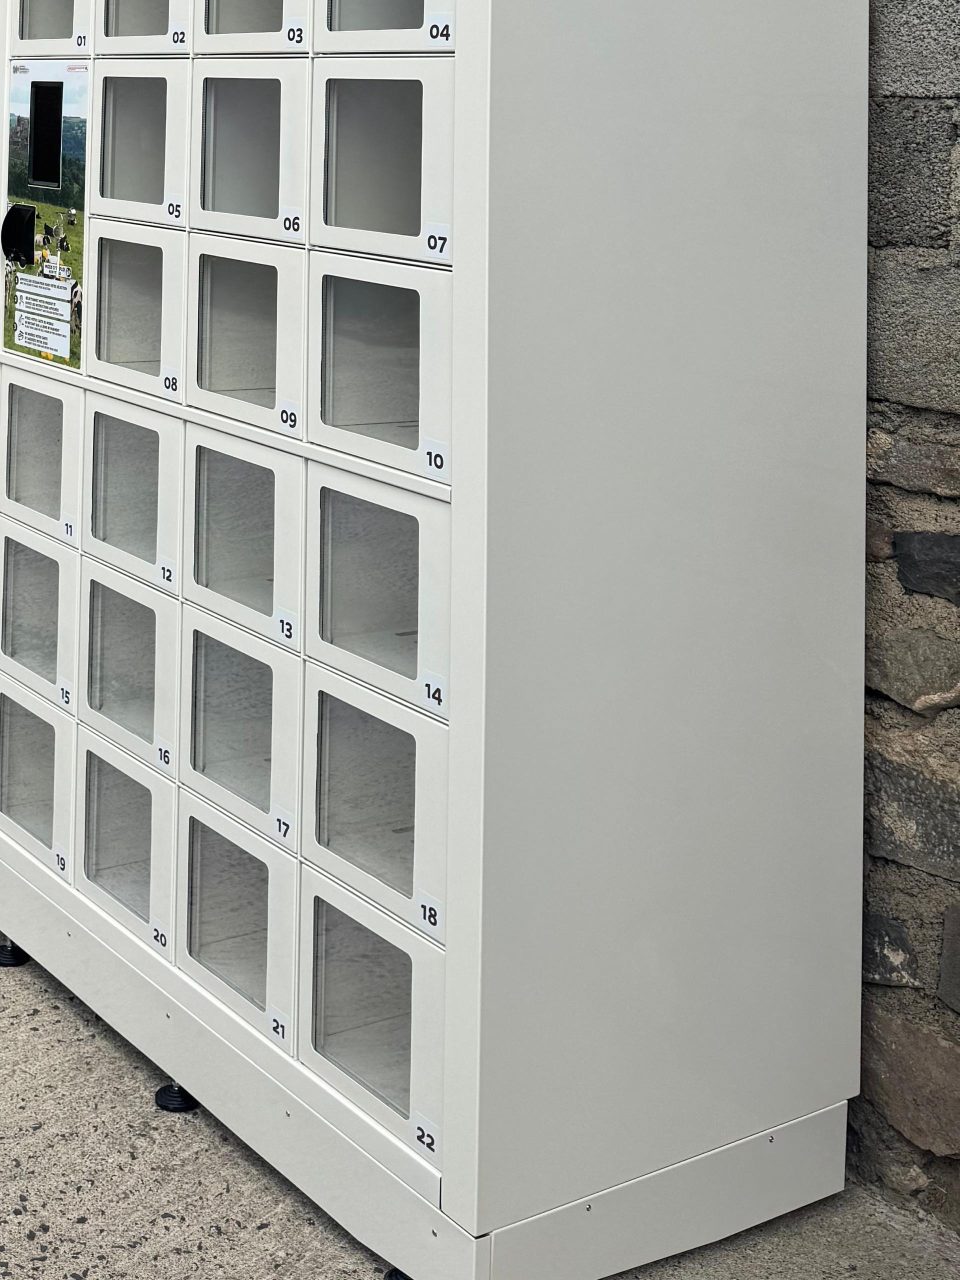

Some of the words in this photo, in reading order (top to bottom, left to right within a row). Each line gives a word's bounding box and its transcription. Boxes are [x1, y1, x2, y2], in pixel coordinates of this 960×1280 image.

[76, 35, 87, 47] 01
[172, 31, 186, 44] 02
[287, 27, 303, 44] 03
[429, 24, 451, 42] 04
[167, 202, 181, 219] 05
[283, 216, 300, 232] 06
[427, 234, 448, 254] 07
[163, 376, 178, 392] 08
[280, 409, 297, 429] 09
[426, 451, 444, 470] 10
[64, 522, 73, 537] 11
[161, 566, 172, 583] 12
[279, 619, 293, 640] 13
[60, 687, 71, 705] 15
[424, 683, 443, 706] 14
[158, 747, 170, 765] 16
[276, 818, 290, 838] 17
[56, 853, 66, 872] 19
[420, 904, 438, 927] 18
[153, 927, 167, 948] 20
[272, 1018, 285, 1040] 21
[416, 1126, 436, 1153] 22
